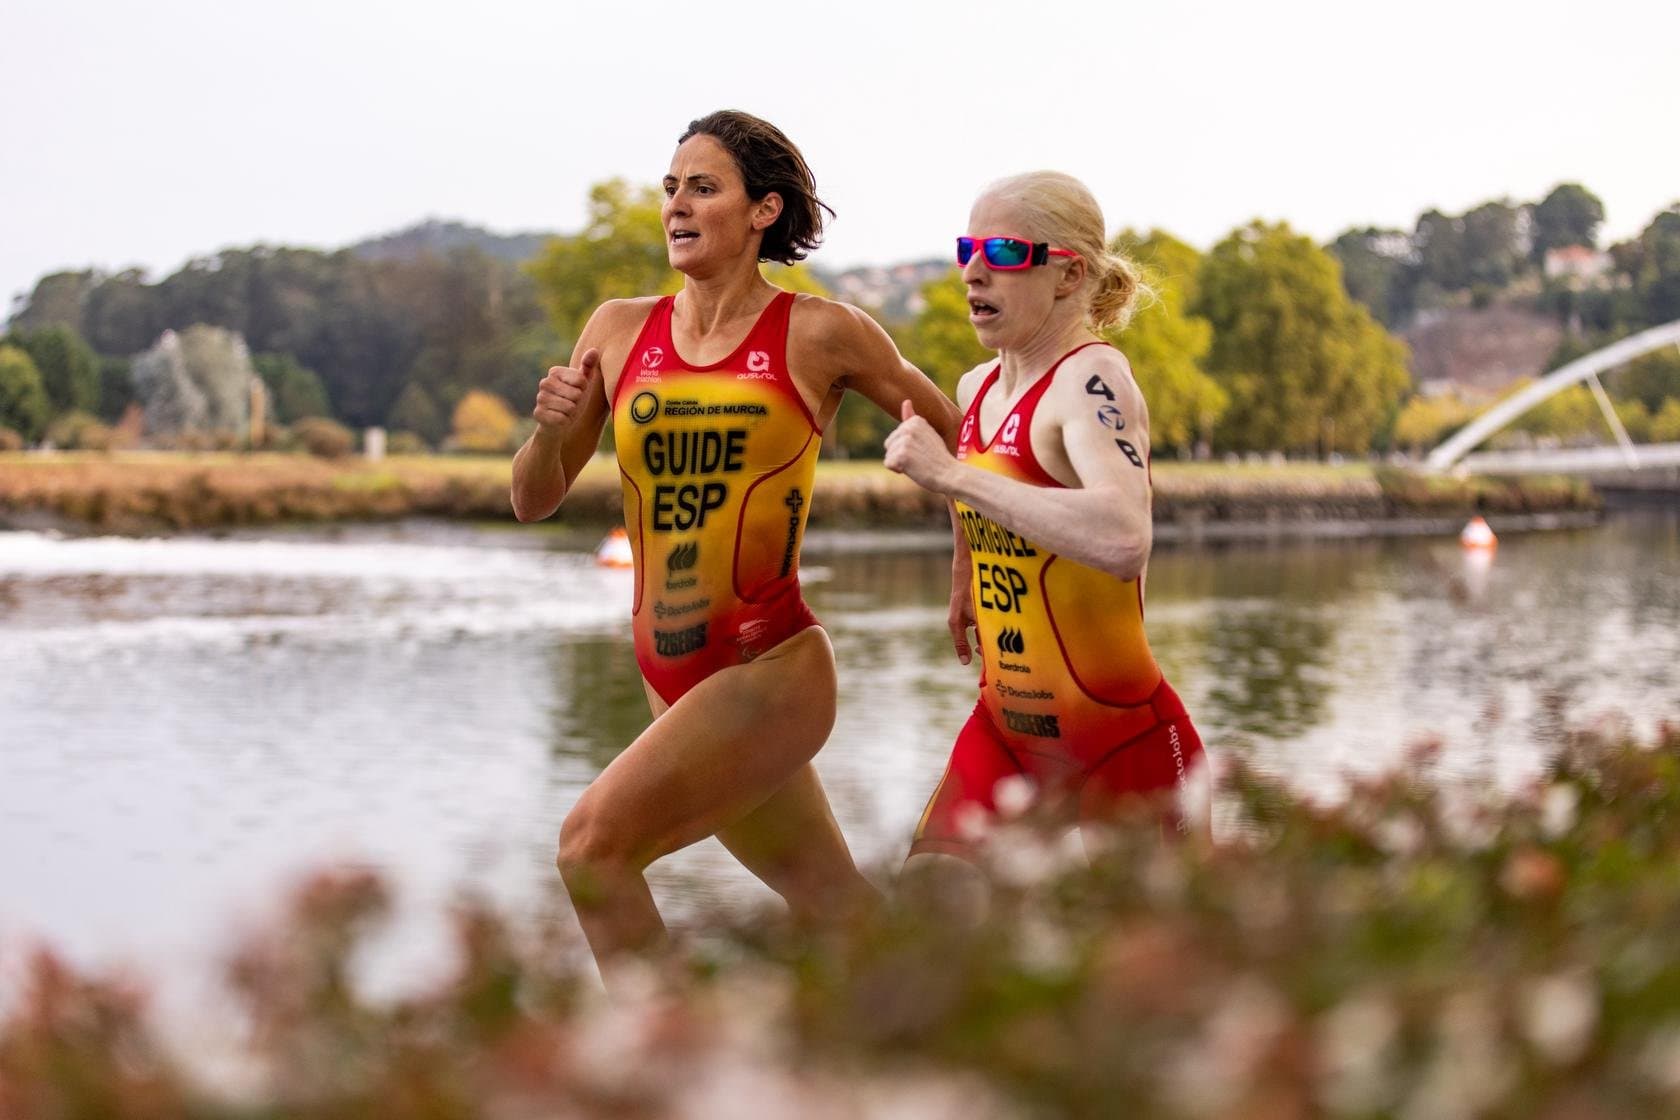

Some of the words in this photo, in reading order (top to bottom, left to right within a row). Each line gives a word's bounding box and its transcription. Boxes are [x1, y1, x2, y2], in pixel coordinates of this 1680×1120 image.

[664, 405, 705, 416] REGIÓN
[708, 406, 721, 415] DE
[723, 405, 768, 415] MURCIA
[1085, 374, 1116, 401] 4
[644, 429, 746, 476] GUIDE
[1115, 438, 1144, 469] B
[653, 482, 727, 531] ESP
[961, 511, 1037, 557] ODRIGUEZ
[978, 562, 1028, 614] ESP
